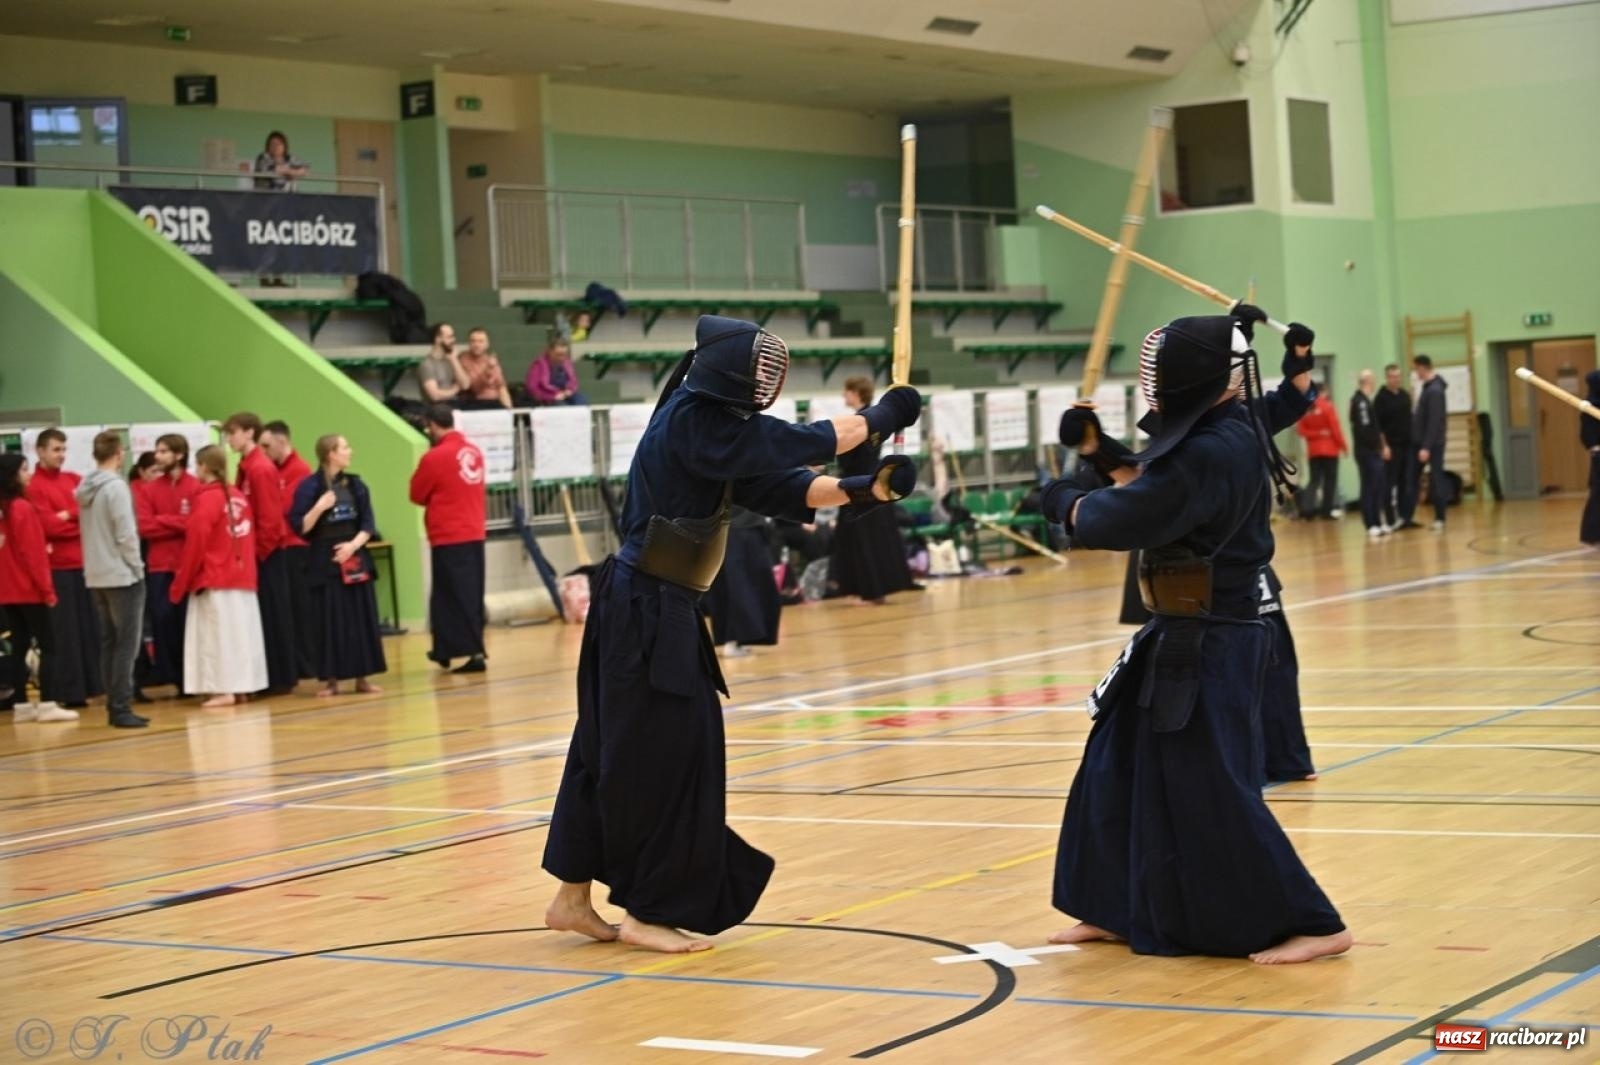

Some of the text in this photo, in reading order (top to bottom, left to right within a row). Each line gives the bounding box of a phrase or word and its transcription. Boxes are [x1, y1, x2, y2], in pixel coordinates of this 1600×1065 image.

[187, 85, 206, 102] F
[409, 93, 427, 115] F
[247, 215, 356, 247] RACIBÓRZ
